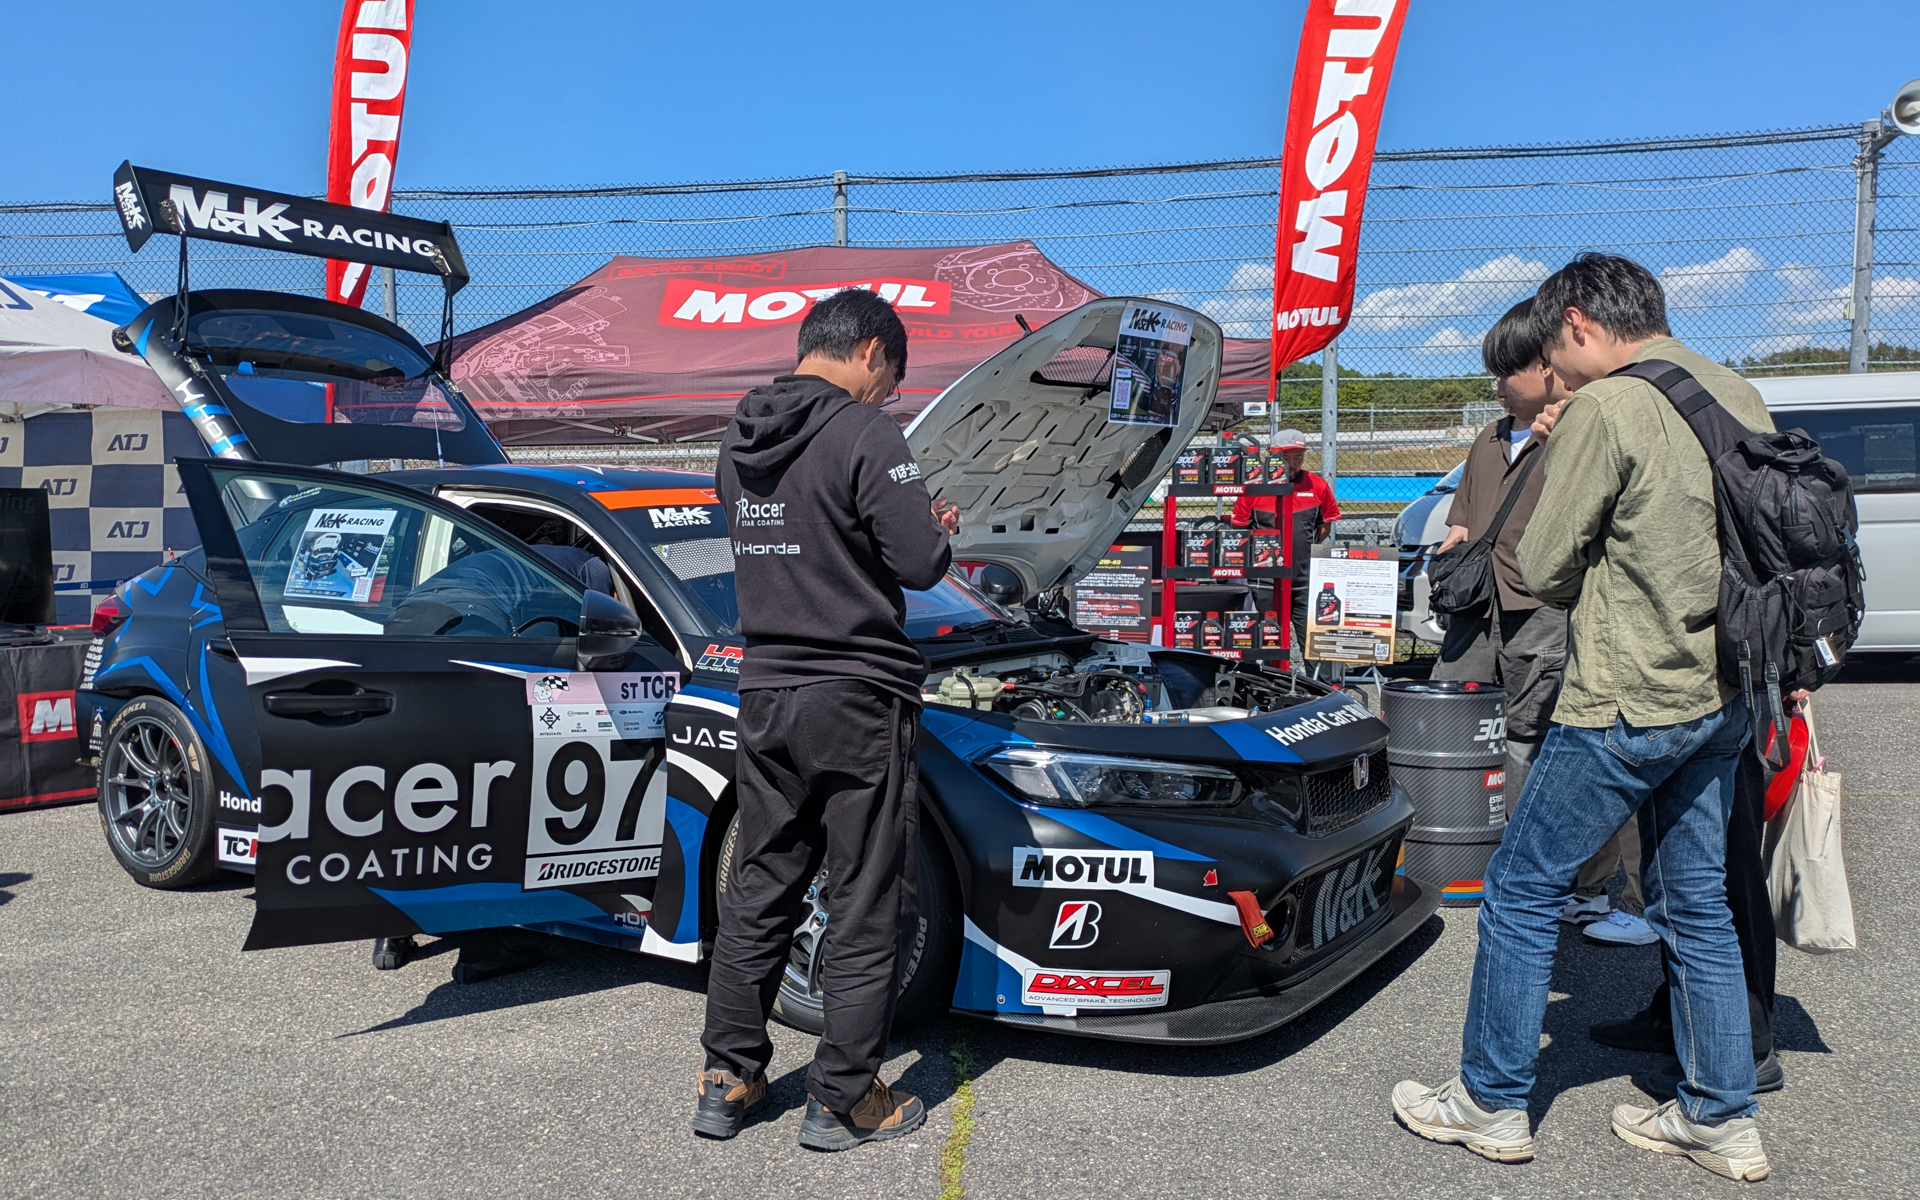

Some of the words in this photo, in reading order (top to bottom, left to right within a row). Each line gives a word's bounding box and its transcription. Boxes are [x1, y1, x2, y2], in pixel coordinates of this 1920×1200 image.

[302, 218, 436, 257] RACING
[1161, 318, 1188, 333] RACING
[1277, 306, 1342, 331] MOTUL
[107, 434, 149, 452] ATJ
[741, 497, 785, 518] Racer
[107, 521, 150, 538] ATJ
[346, 518, 385, 527] RACING
[653, 520, 711, 529] RACING
[742, 542, 801, 555] Honda
[53, 564, 76, 581] TJ
[695, 665, 723, 673] Honda
[621, 683, 638, 700] ST
[640, 676, 677, 699] TCR
[30, 698, 76, 734] M
[1264, 716, 1331, 747] Honda
[1316, 707, 1358, 727] Cars
[220, 789, 262, 813] Hond
[545, 739, 667, 846] 97
[149, 847, 191, 882] BRIDGESTONE
[286, 843, 493, 885] COATING
[537, 855, 661, 881] BRIDGESTONE
[1020, 854, 1148, 885] MOTUL
[1027, 973, 1165, 998] DIXCEL
[1028, 995, 1075, 1003] ADVANCED
[1109, 996, 1163, 1004] TECHNOLOGY
